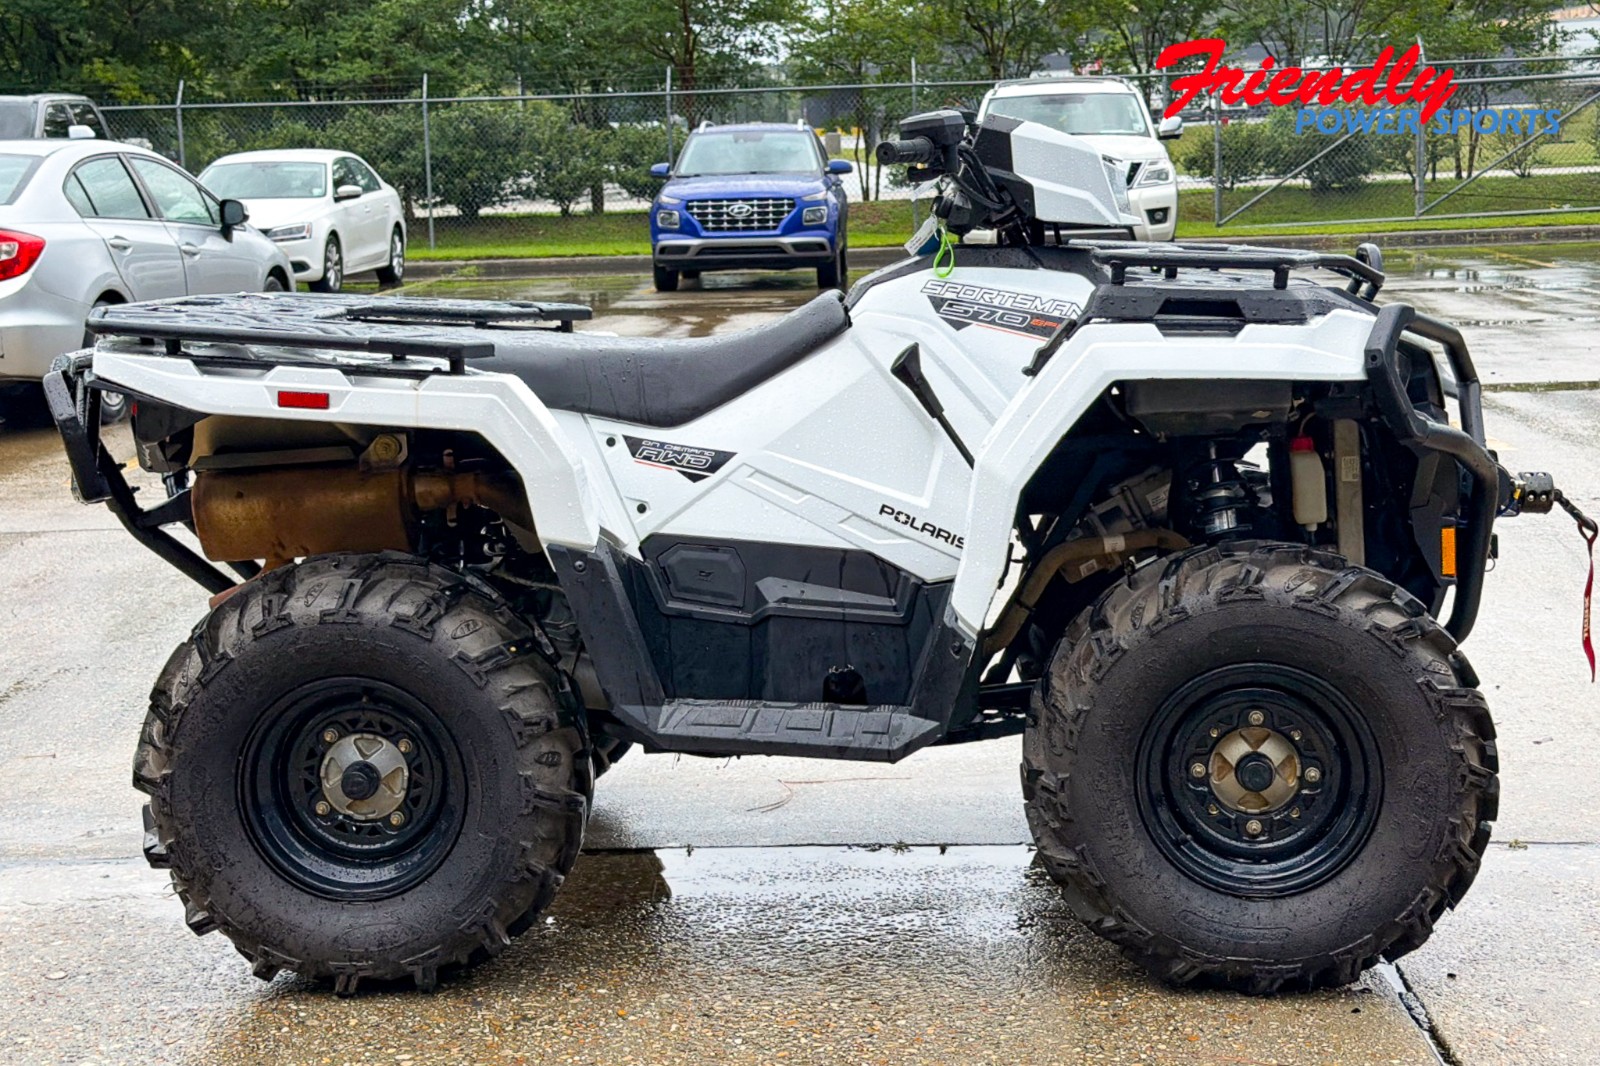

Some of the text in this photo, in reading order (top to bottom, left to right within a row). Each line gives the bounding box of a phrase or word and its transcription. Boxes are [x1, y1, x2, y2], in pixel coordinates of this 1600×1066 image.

[920, 279, 1084, 319] SPORTSMAN
[940, 300, 1031, 328] 570
[635, 446, 712, 469] AWD
[642, 440, 716, 457] ON DEMAND
[878, 503, 965, 550] POLARIS
